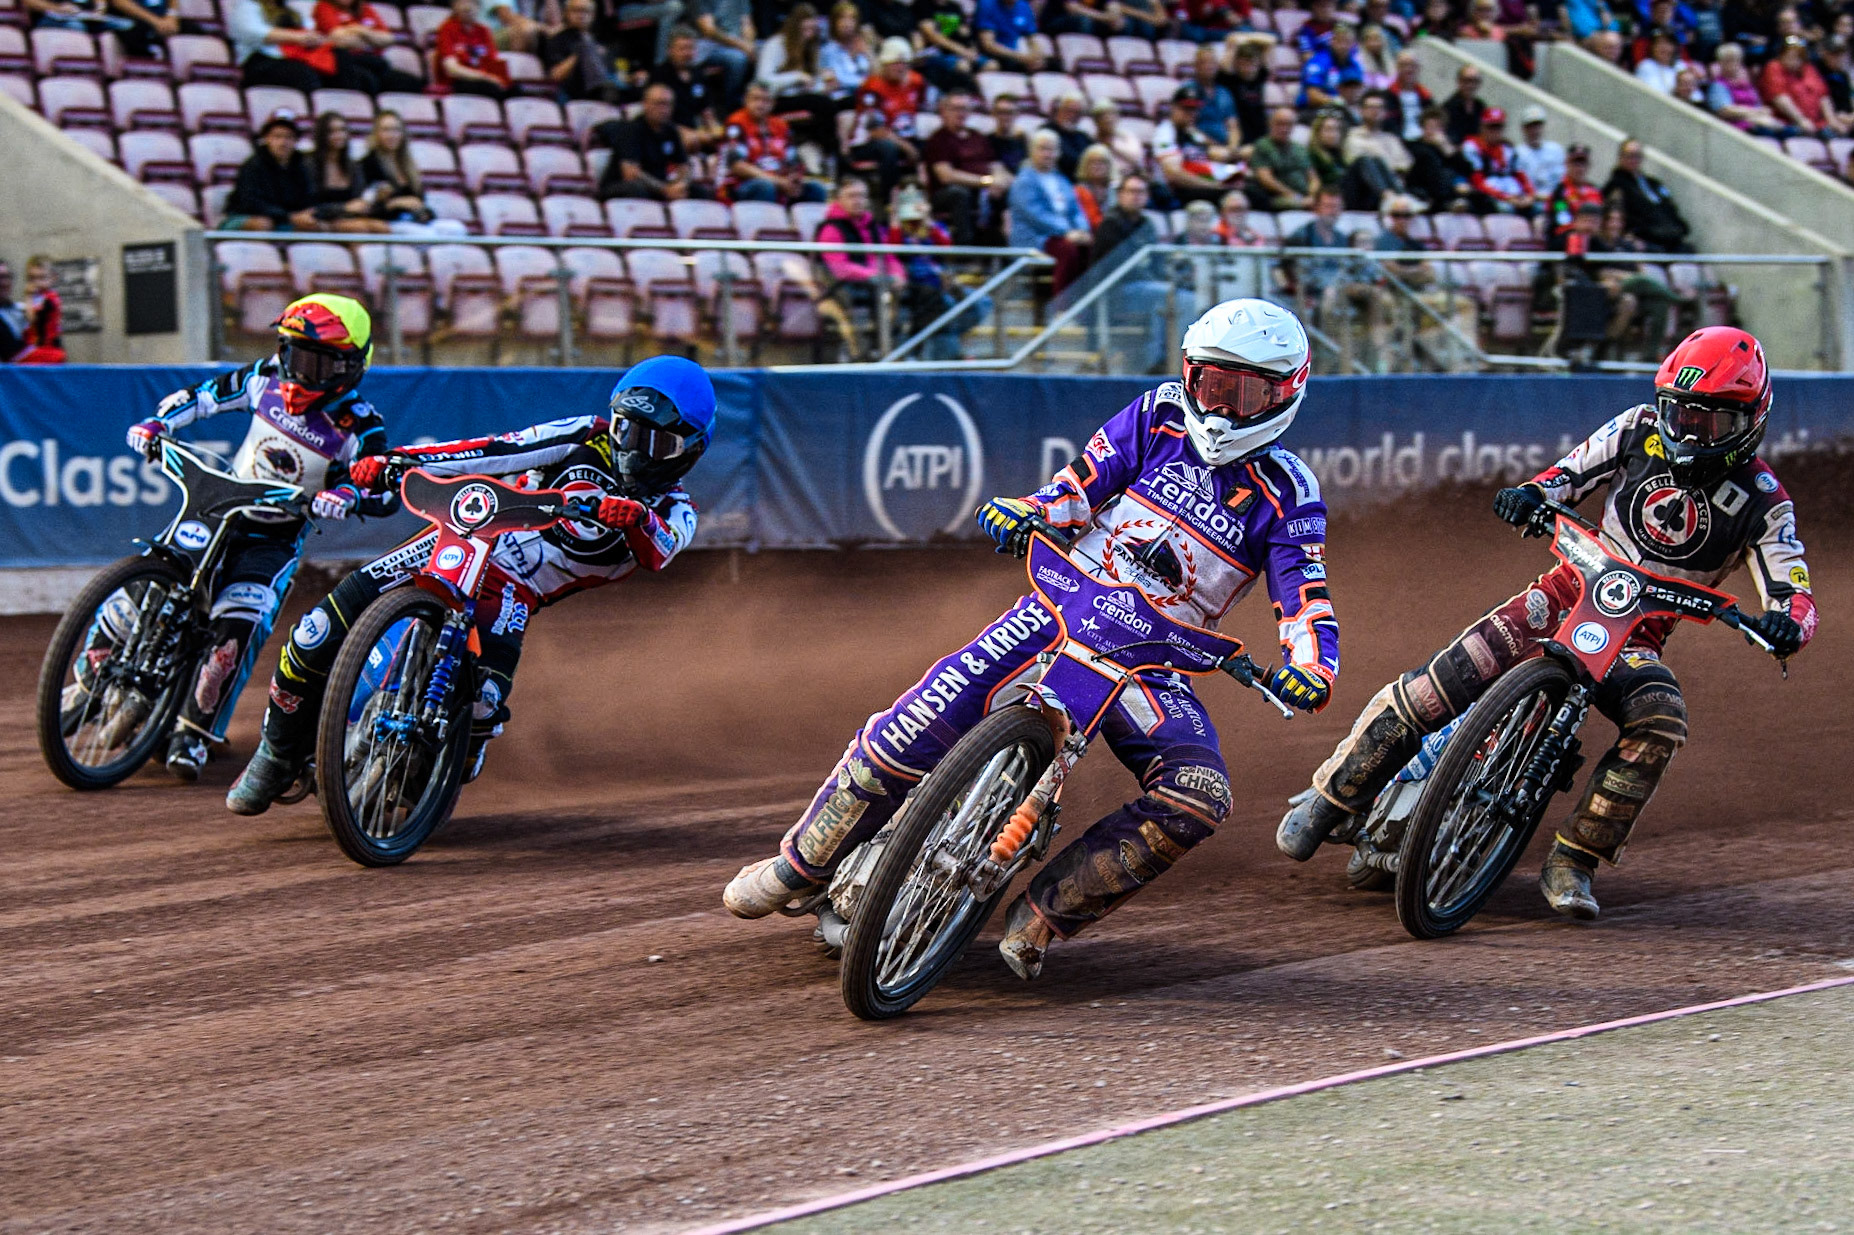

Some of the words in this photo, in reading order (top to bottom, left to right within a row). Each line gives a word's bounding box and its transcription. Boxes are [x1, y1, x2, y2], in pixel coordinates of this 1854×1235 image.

[269, 406, 325, 447] Crendon
[885, 445, 964, 490] ATPI
[1299, 431, 1425, 486] world
[0, 439, 170, 507] Class
[568, 469, 604, 485] BELLE
[1644, 478, 1676, 493] BELLE
[1227, 488, 1253, 508] 1
[1147, 488, 1179, 513] TIMBER
[1180, 508, 1237, 553] ENGINEERING
[1697, 502, 1708, 530] ACES
[443, 553, 458, 562] ATPI
[1039, 565, 1072, 586] FASTRACK
[1124, 566, 1152, 588] 2023
[1093, 594, 1152, 635] Crendon
[1579, 629, 1601, 645] ATPI
[881, 666, 970, 753] HANSEN
[959, 652, 989, 675] &
[977, 602, 1052, 662] KRUSE
